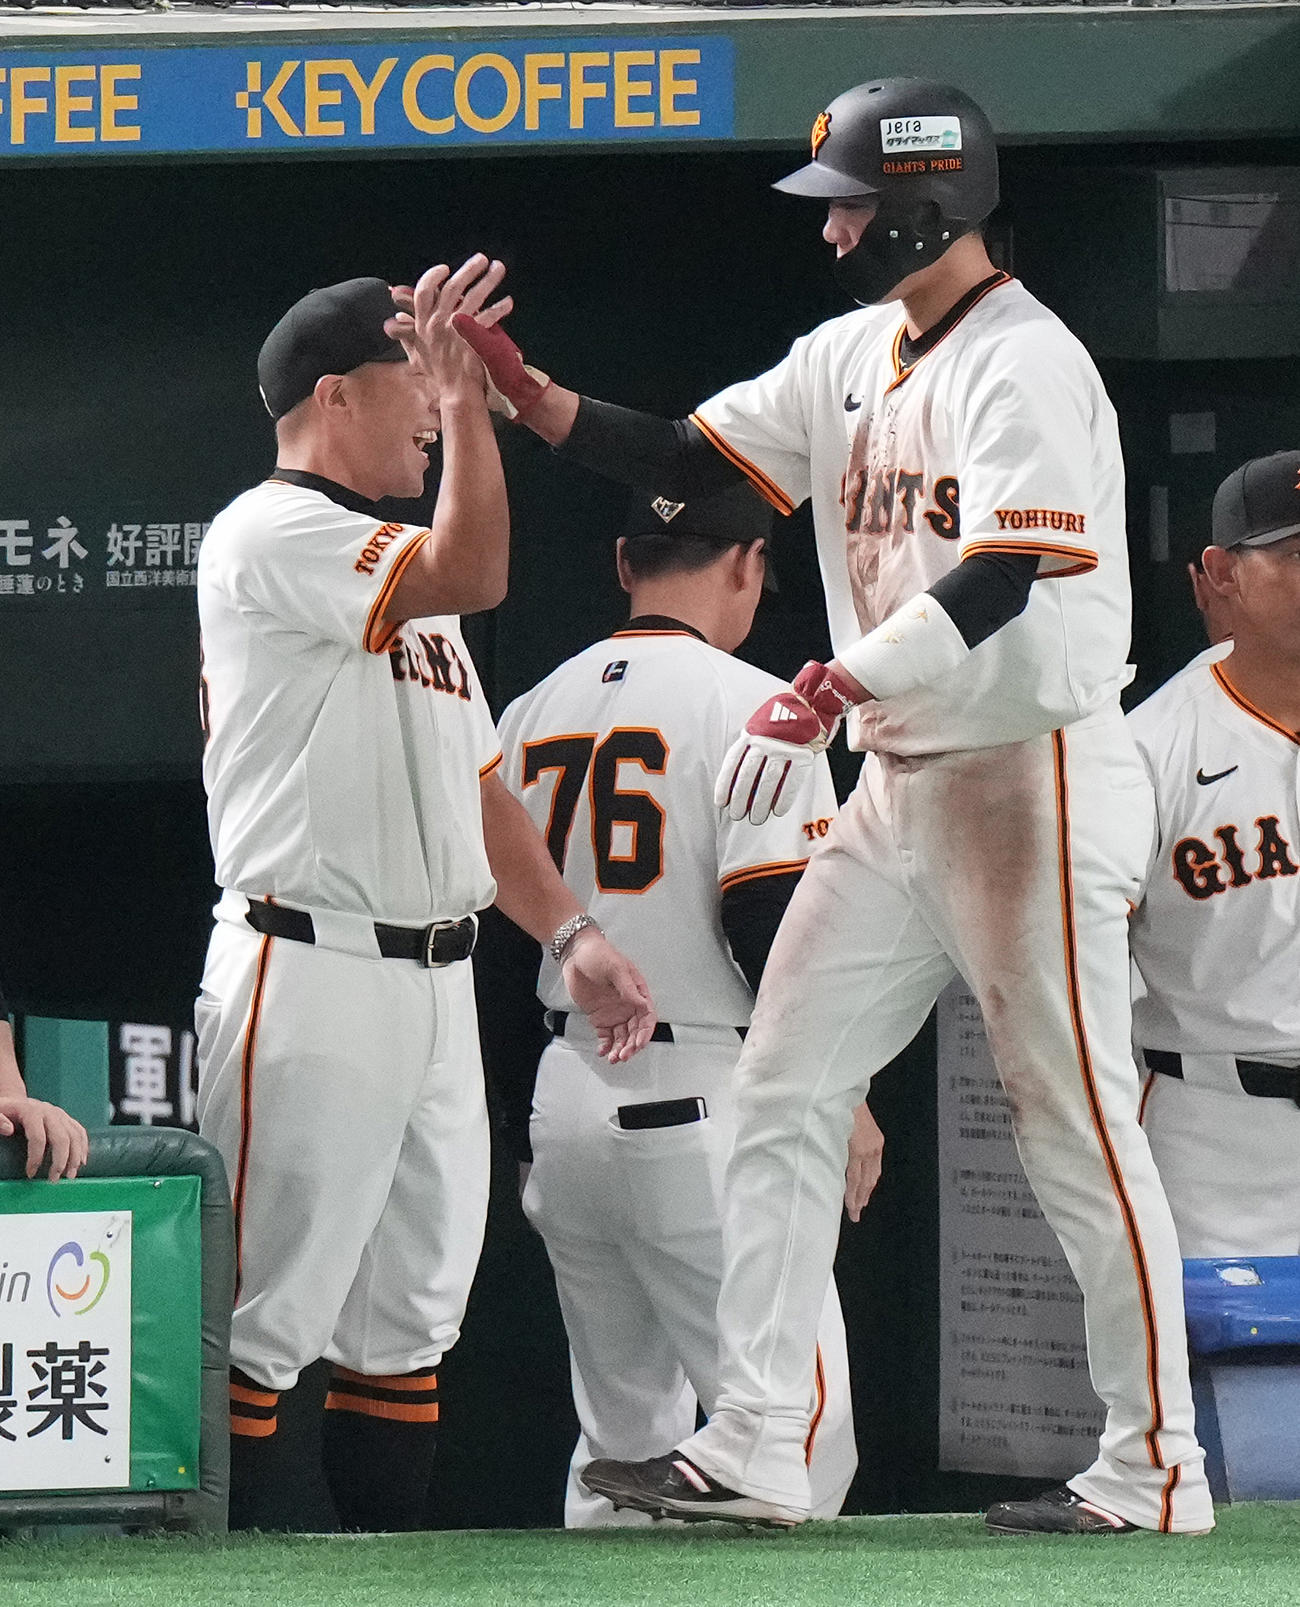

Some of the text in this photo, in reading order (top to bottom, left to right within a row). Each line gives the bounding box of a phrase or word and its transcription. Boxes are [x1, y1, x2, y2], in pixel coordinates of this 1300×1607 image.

[0, 65, 142, 145] FEE
[883, 158, 963, 174] GIANTS PRIDE
[0, 515, 89, 568] モネ
[522, 726, 670, 894] 76
[0, 1340, 110, 1442] 薬
